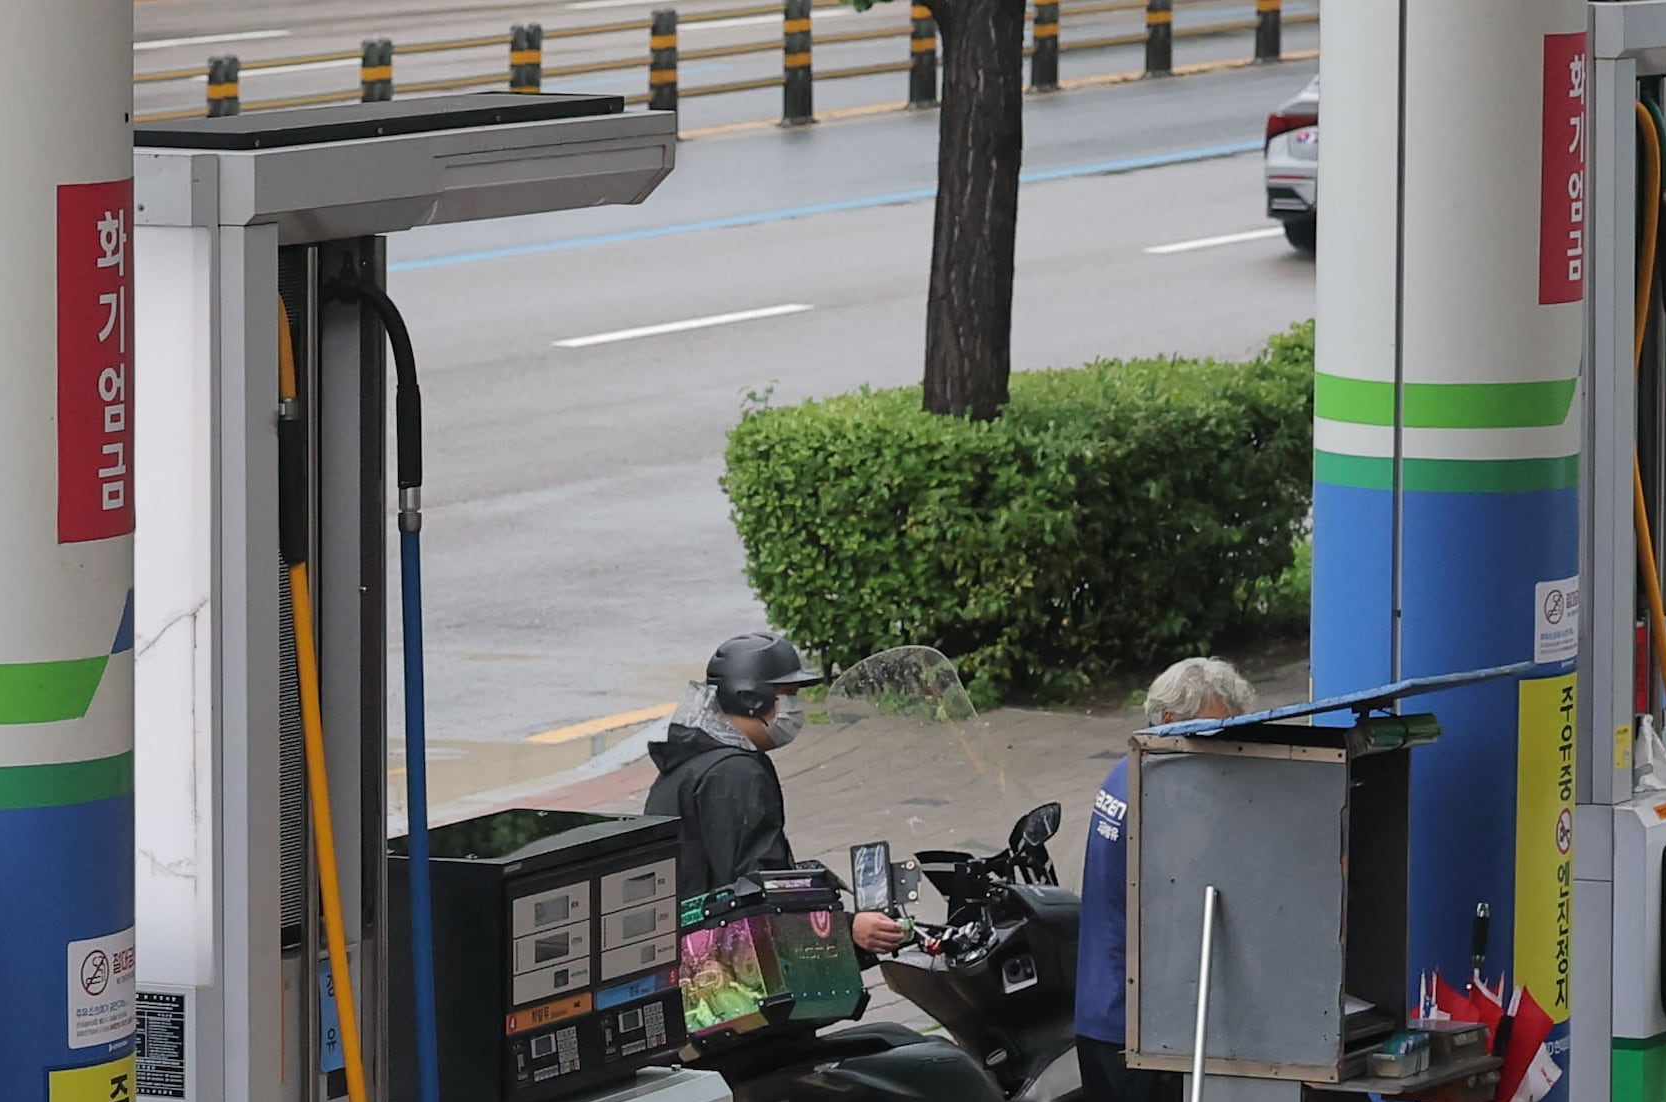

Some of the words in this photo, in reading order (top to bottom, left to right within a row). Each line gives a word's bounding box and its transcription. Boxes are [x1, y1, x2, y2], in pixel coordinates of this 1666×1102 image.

[1567, 52, 1585, 282] 화기엄금
[96, 208, 126, 513] 화기엄금
[1558, 685, 1574, 802] 주유중
[1555, 859, 1571, 1010] 엔진정지
